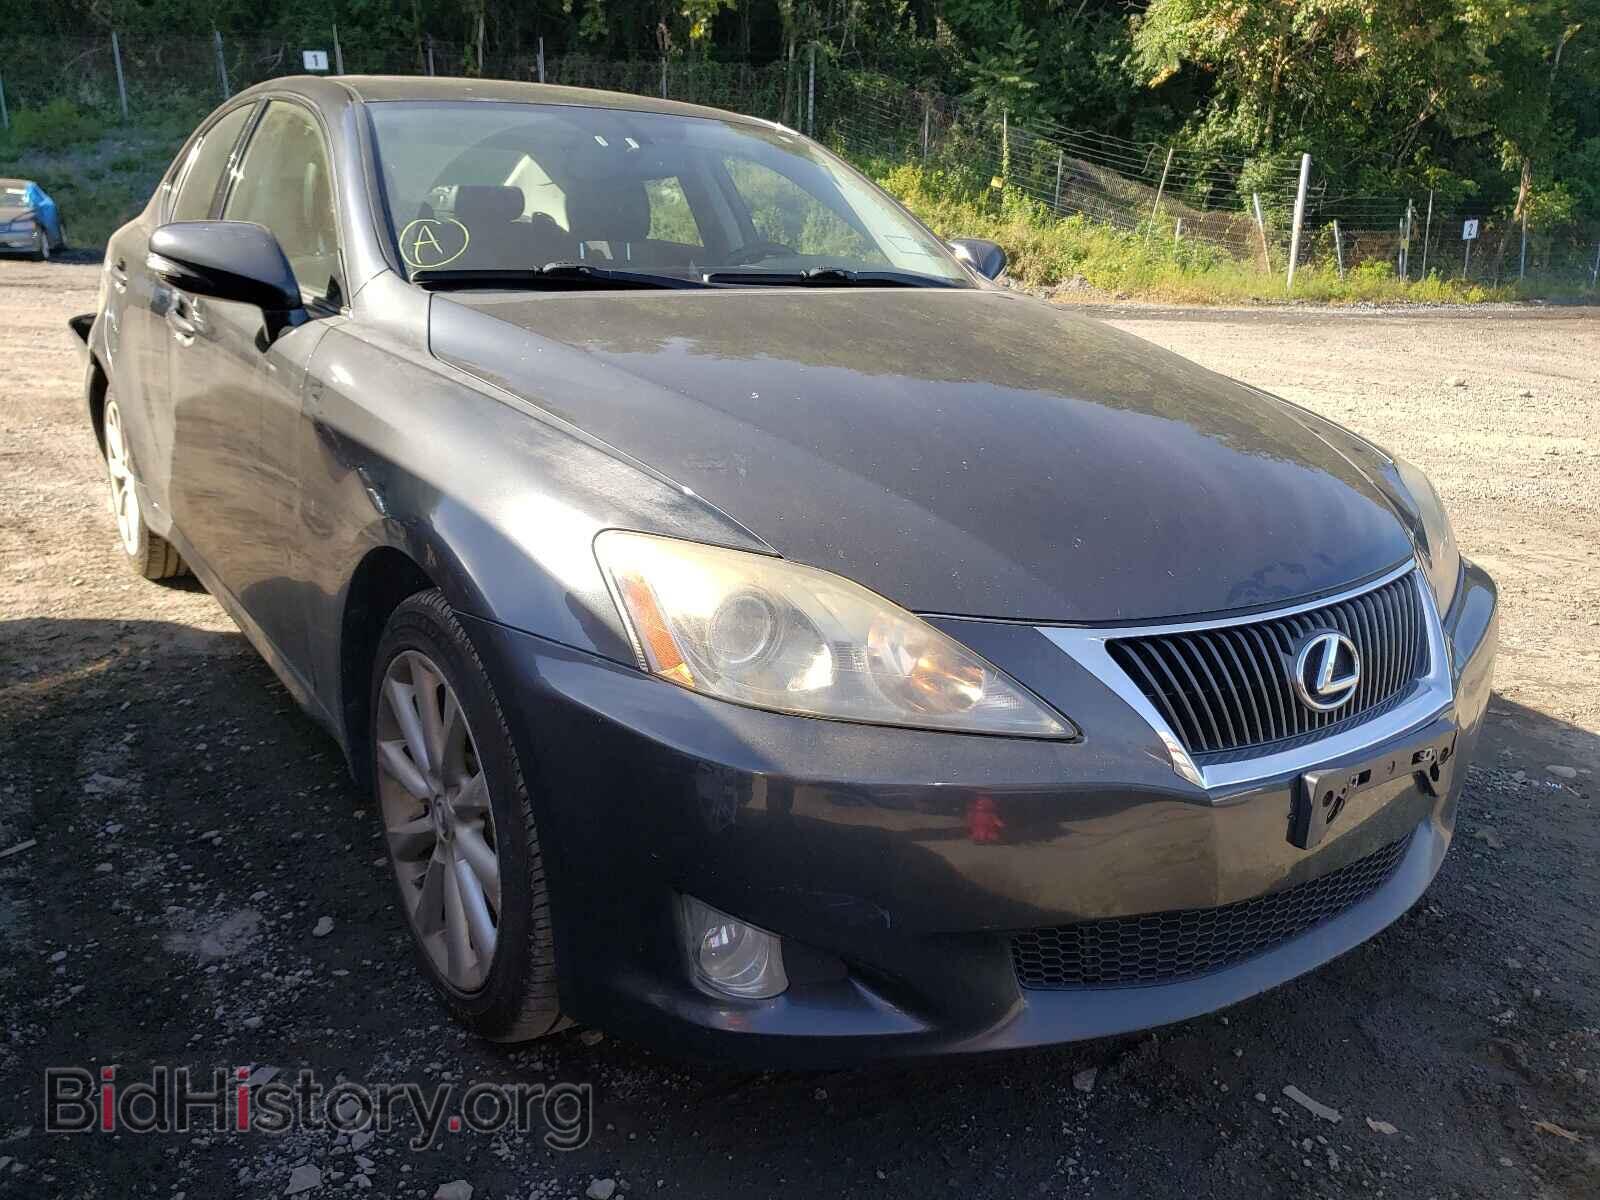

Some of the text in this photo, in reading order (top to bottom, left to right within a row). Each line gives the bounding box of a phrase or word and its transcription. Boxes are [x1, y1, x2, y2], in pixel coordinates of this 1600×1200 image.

[312, 54, 318, 67] 1
[1467, 223, 1474, 236] 2
[413, 225, 443, 264] A
